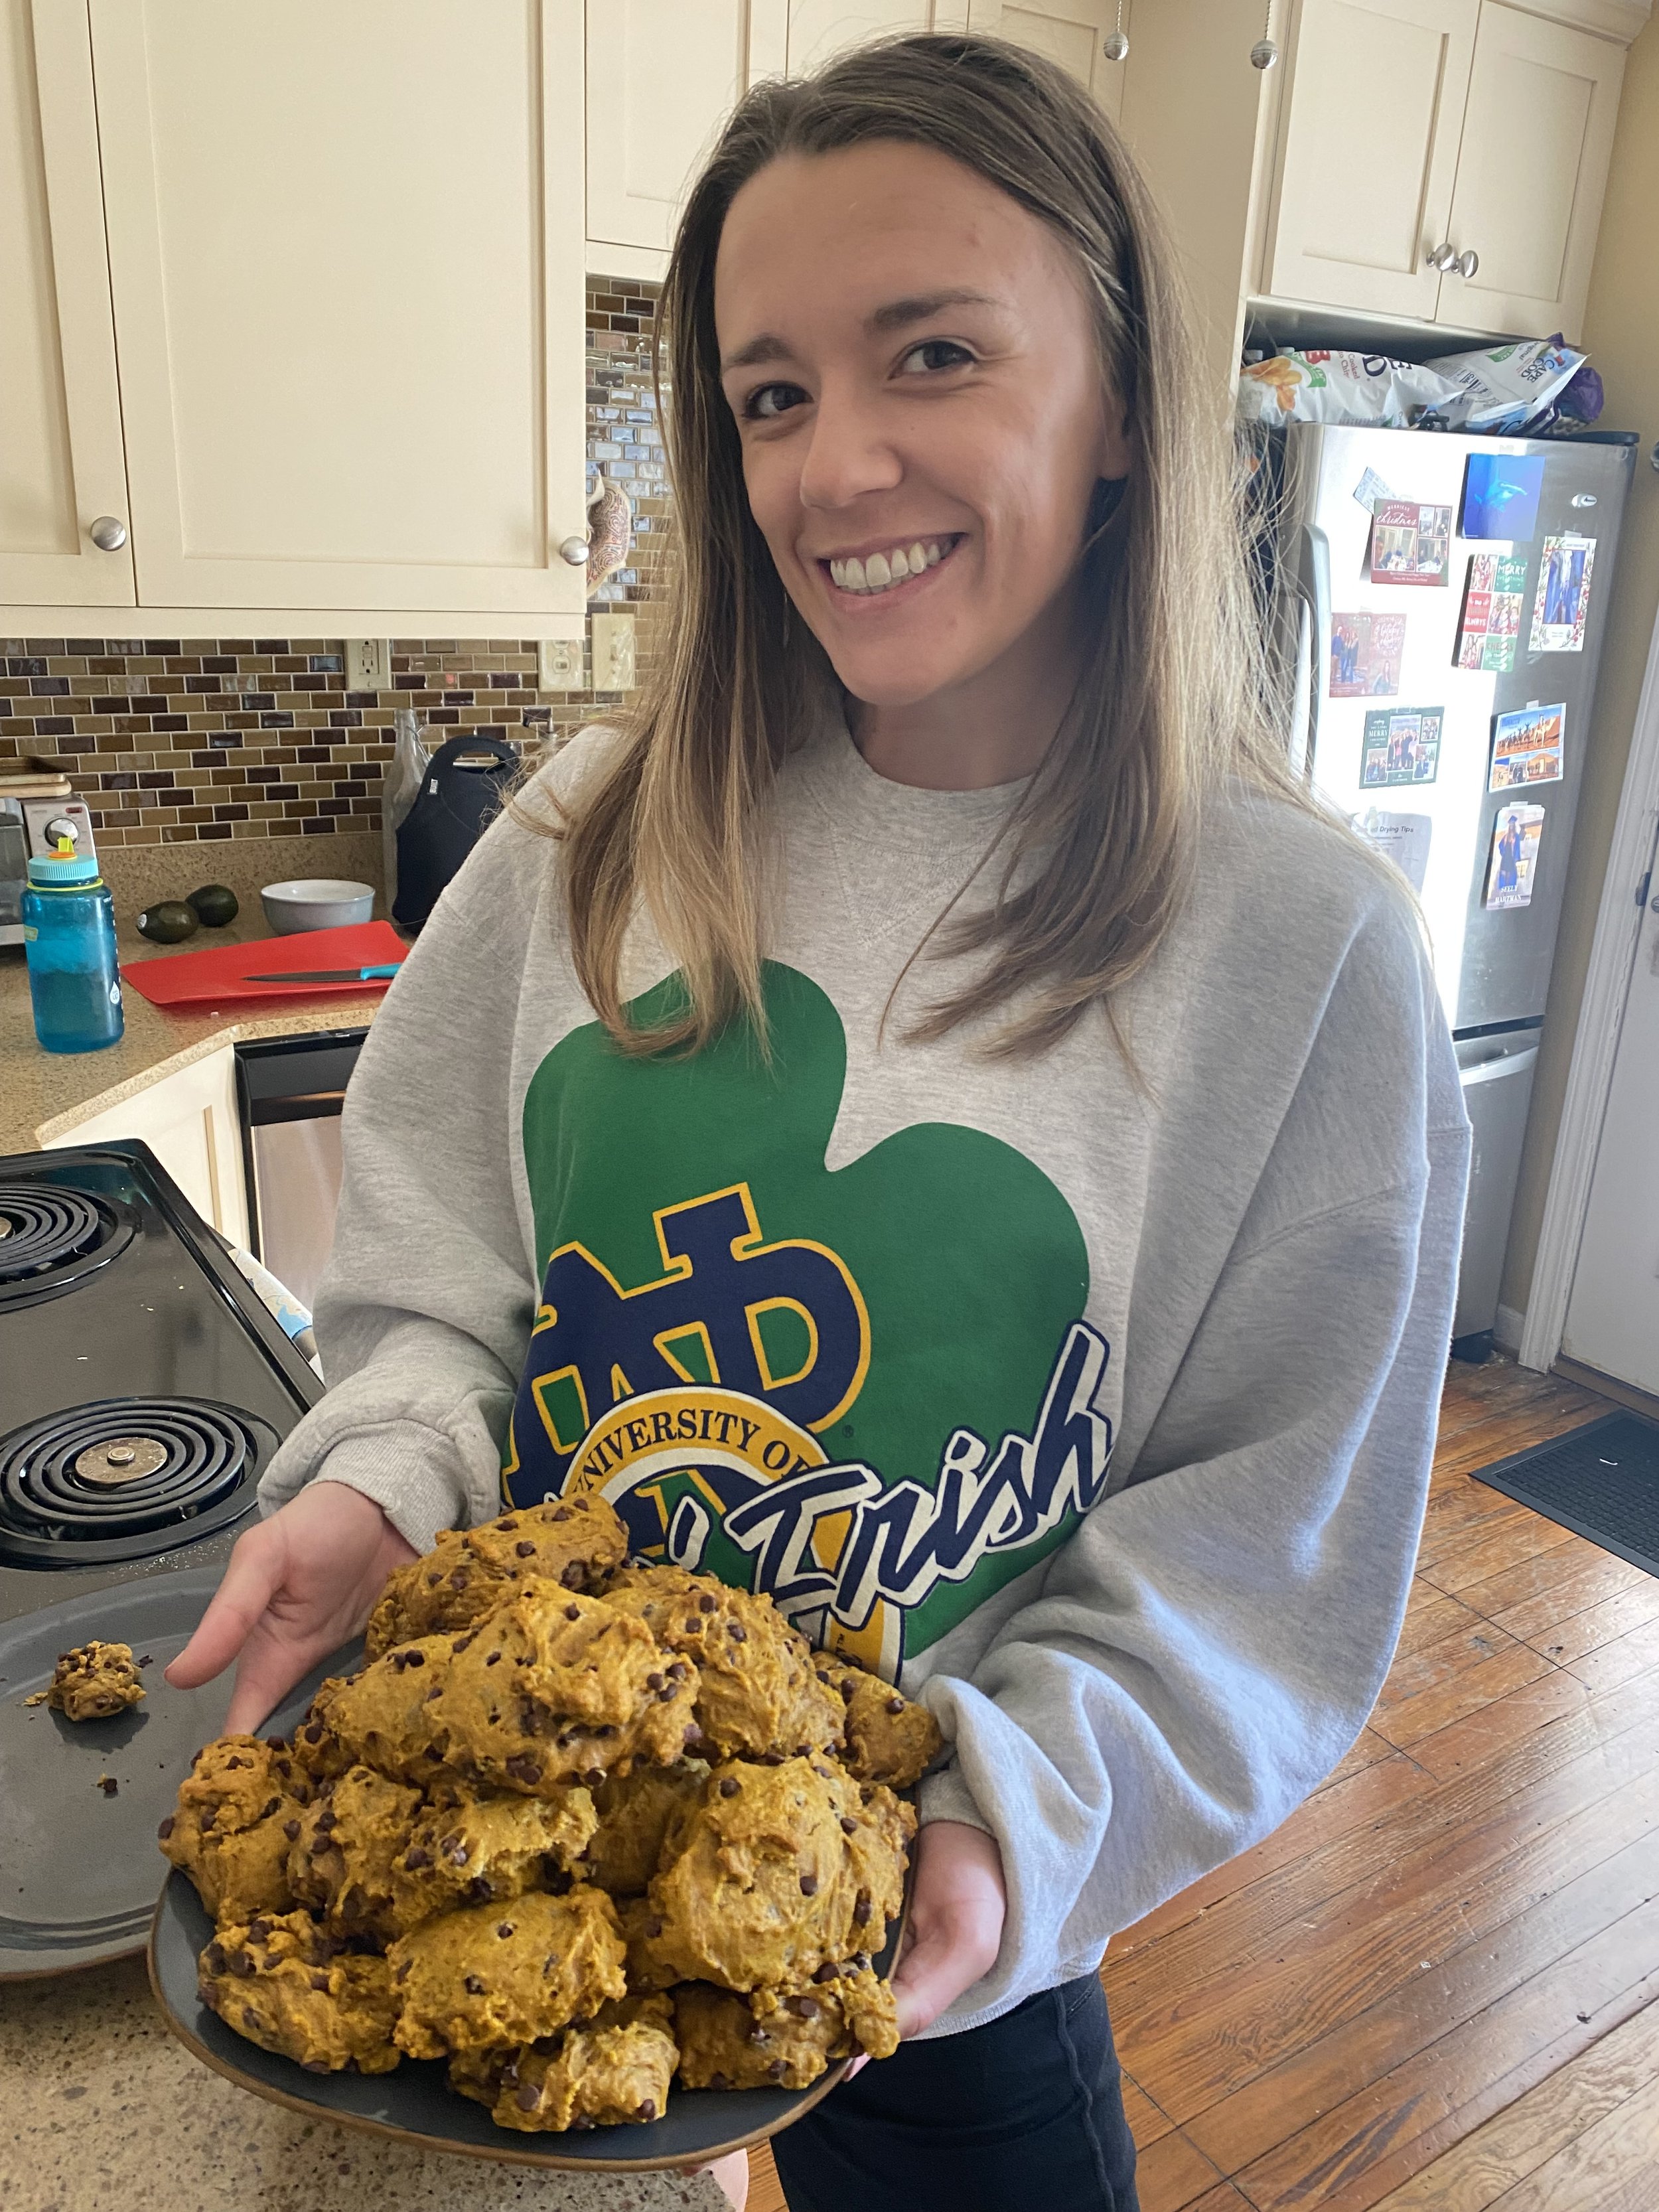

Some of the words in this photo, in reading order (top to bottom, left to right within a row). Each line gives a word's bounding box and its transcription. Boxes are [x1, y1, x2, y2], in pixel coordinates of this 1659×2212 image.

[1340, 359, 1350, 378] Chip
[1348, 353, 1360, 380] Cooked
[1521, 358, 1544, 378] COD
[1527, 359, 1555, 383] CAPE
[1465, 617, 1486, 627] ALWAYS
[1495, 894, 1522, 903] HARTMAN
[573, 1408, 762, 1493] NIVERSITY
[724, 1321, 1114, 1631] Irish
